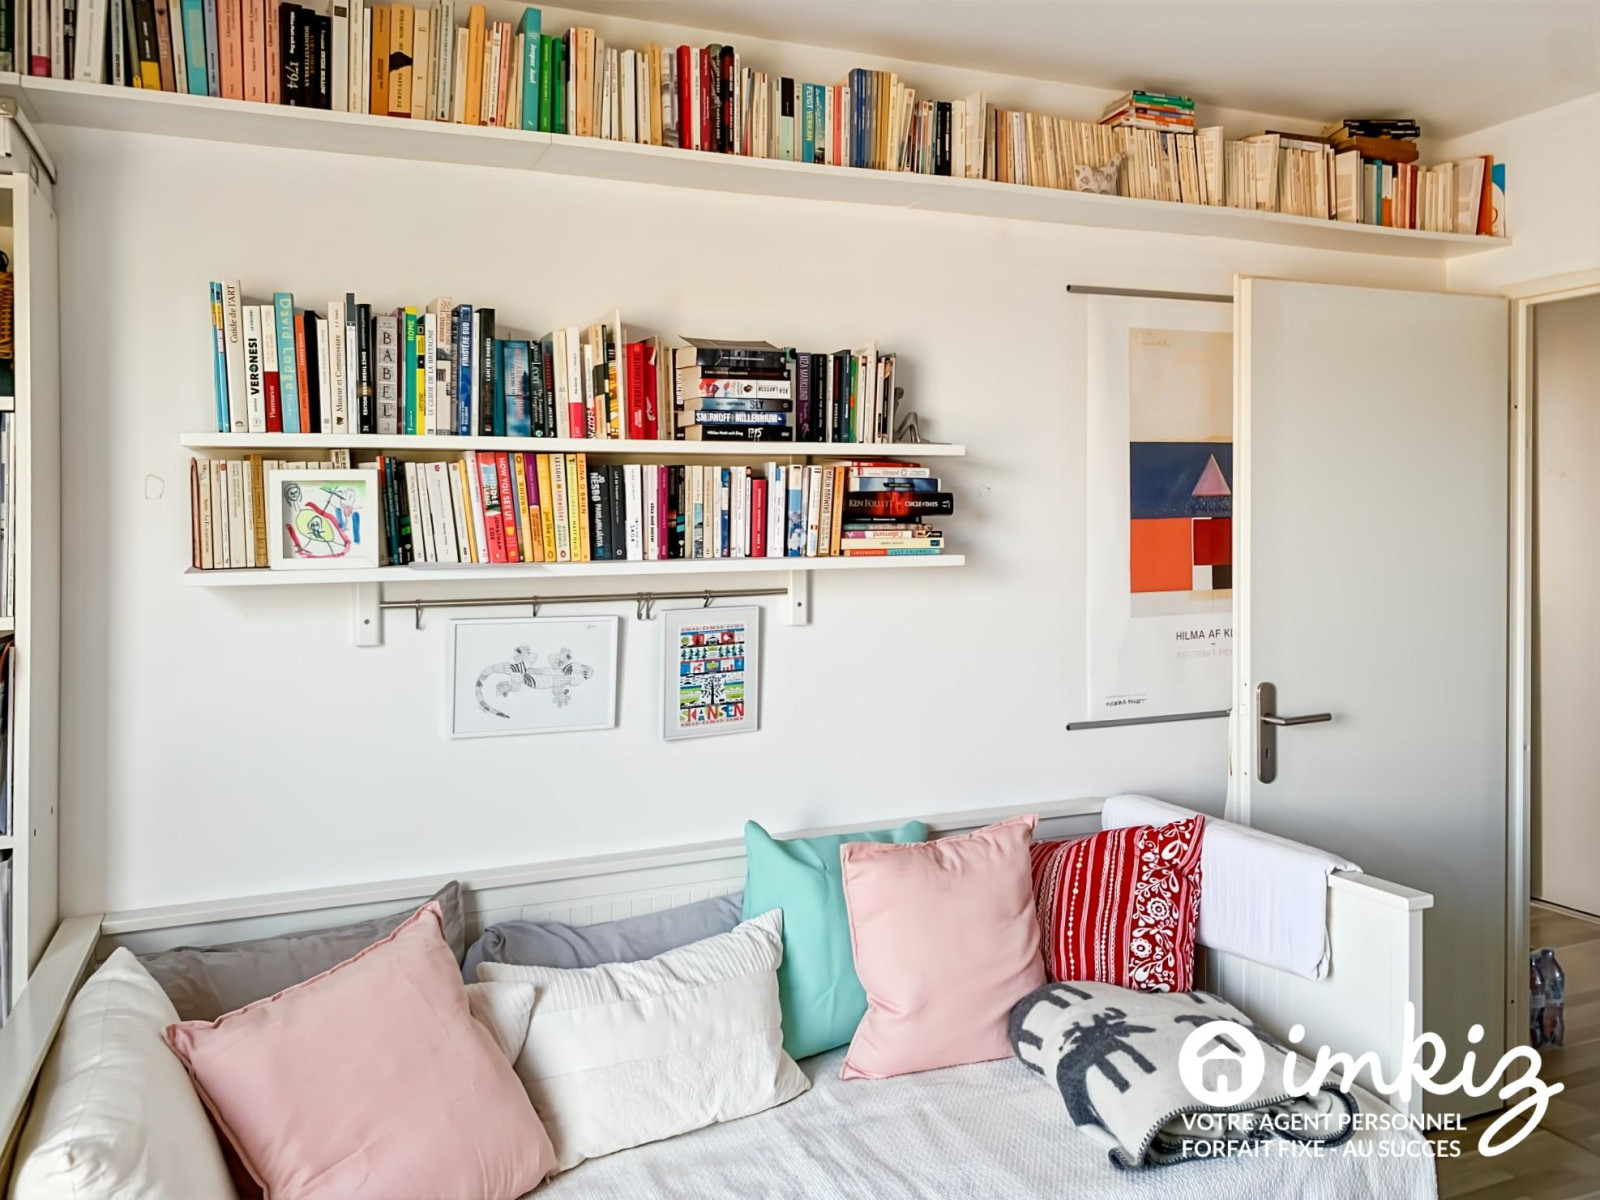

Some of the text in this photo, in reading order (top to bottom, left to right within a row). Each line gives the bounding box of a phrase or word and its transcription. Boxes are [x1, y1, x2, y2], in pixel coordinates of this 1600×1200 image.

[529, 43, 537, 67] Jesper
[285, 60, 299, 89] 1794
[805, 86, 814, 141] FLYGT VERKAN
[227, 285, 238, 343] Guide de l'ART
[279, 298, 291, 340] David
[461, 322, 470, 367] FINISTÈRE SUD
[248, 338, 259, 395] VERONESI
[281, 348, 294, 390] Lodge
[383, 332, 393, 417] BABEL
[531, 362, 541, 384] Leon
[799, 356, 808, 401] LIZA MARKLUND
[428, 376, 433, 384] DE
[750, 400, 764, 409] SLY
[696, 413, 777, 422] SMIRNOFF MILLENNIUM
[501, 478, 509, 494] YOU
[590, 472, 601, 502] NESBØ
[599, 475, 605, 483] JO
[503, 496, 511, 509] SEE
[504, 511, 512, 521] US
[494, 517, 502, 550] JONATHAN
[545, 536, 553, 547] you
[1176, 630, 1205, 641] HILMA
[1209, 629, 1221, 638] AF
[680, 701, 744, 722] SKANSEN
